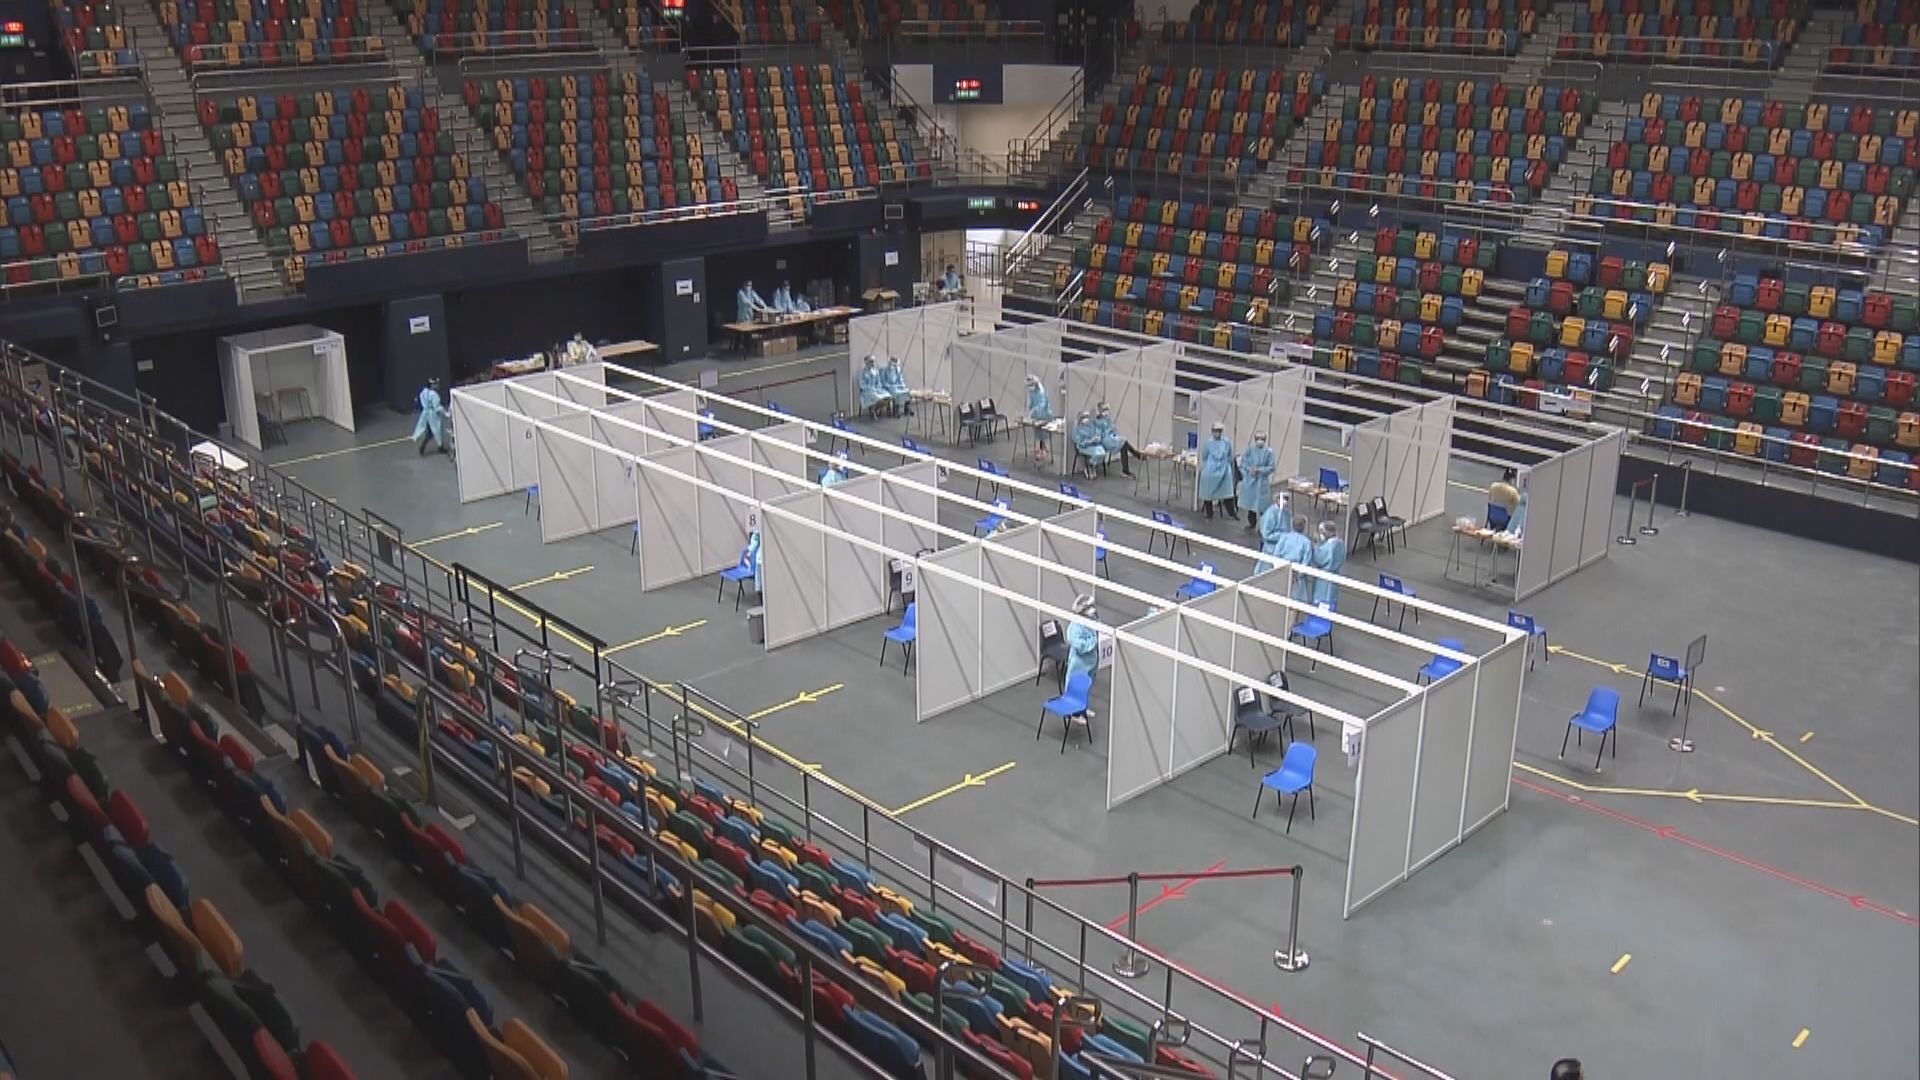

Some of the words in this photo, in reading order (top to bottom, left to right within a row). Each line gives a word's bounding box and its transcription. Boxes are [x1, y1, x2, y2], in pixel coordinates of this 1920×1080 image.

[525, 428, 532, 440] 6
[749, 513, 757, 527] 8
[905, 571, 913, 586] 9
[1101, 646, 1113, 660] 10
